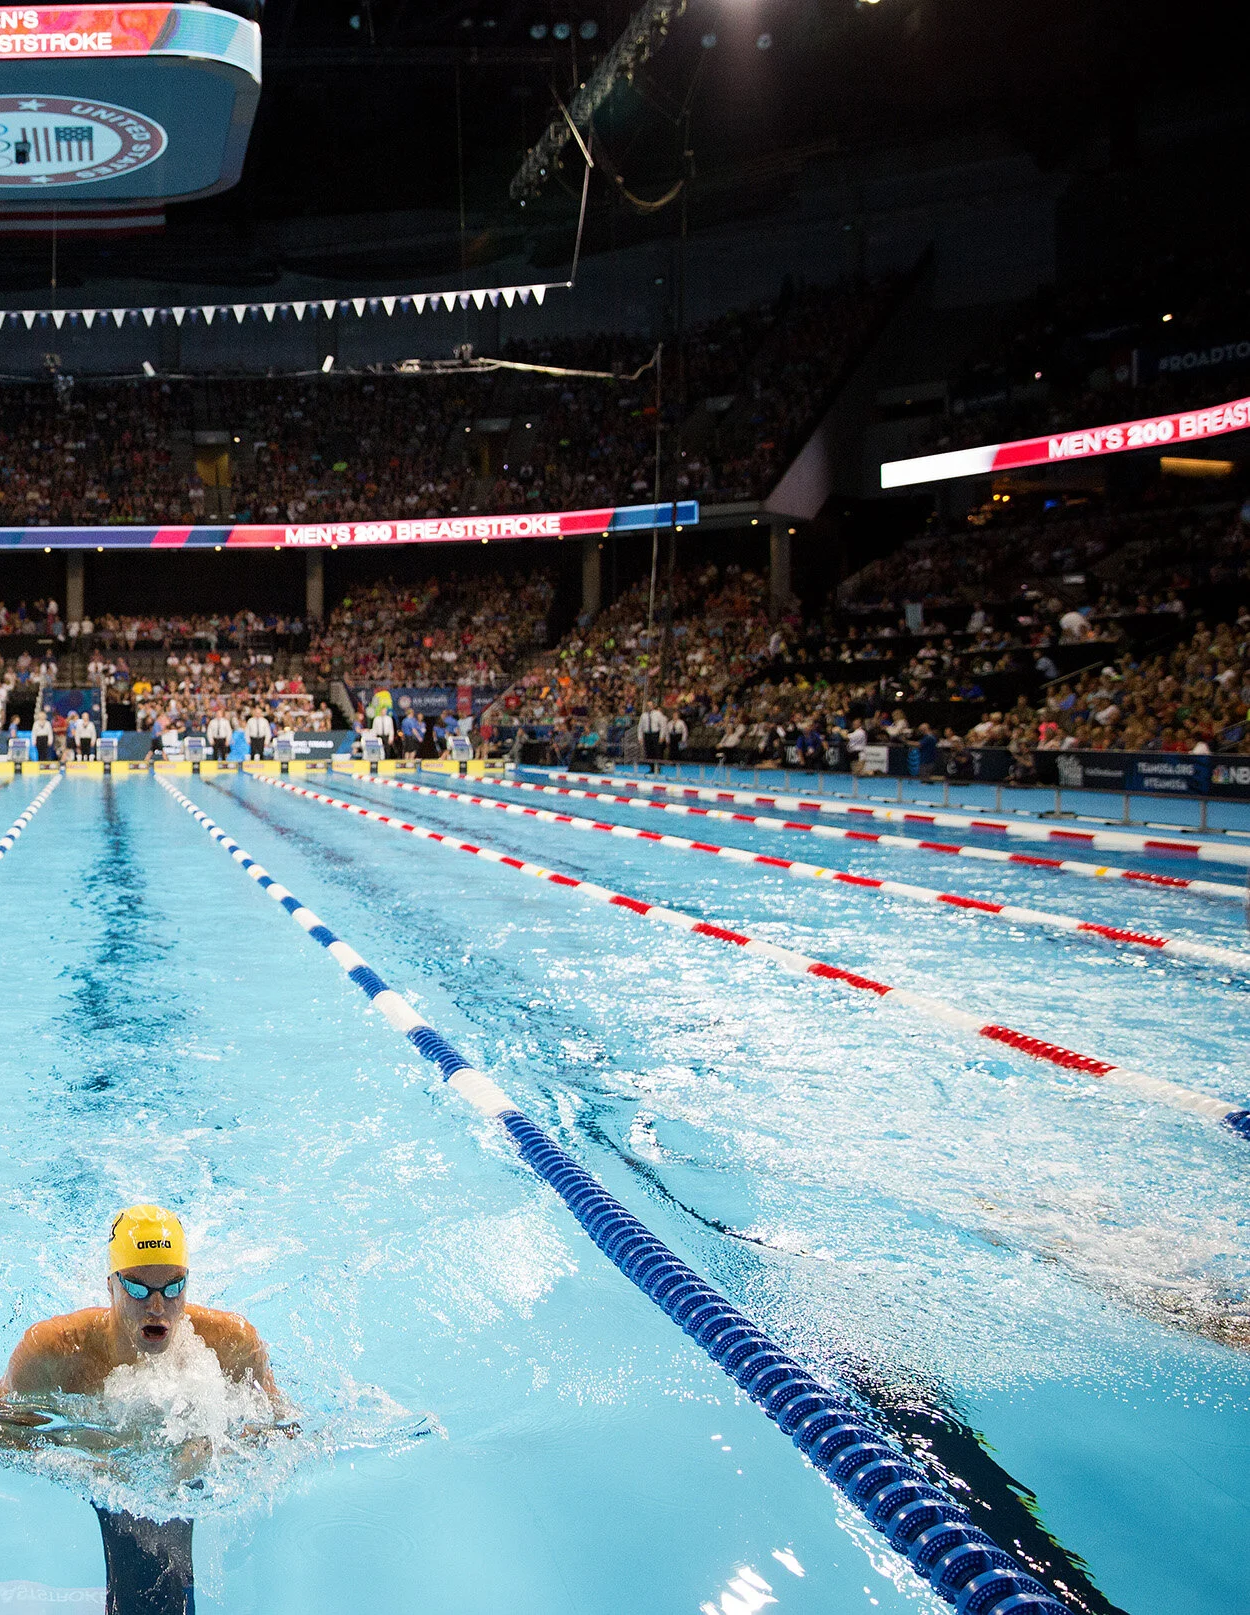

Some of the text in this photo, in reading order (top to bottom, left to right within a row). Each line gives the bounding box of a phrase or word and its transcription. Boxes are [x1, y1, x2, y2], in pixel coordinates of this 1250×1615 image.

[71, 104, 151, 179] UNITED STATES
[1048, 427, 1124, 458] MEN'S
[1127, 420, 1175, 446] 200
[285, 516, 561, 544] MEN'S 200 BREASTSTROKE
[1229, 766, 1250, 784] NB
[137, 1240, 171, 1250] arena
